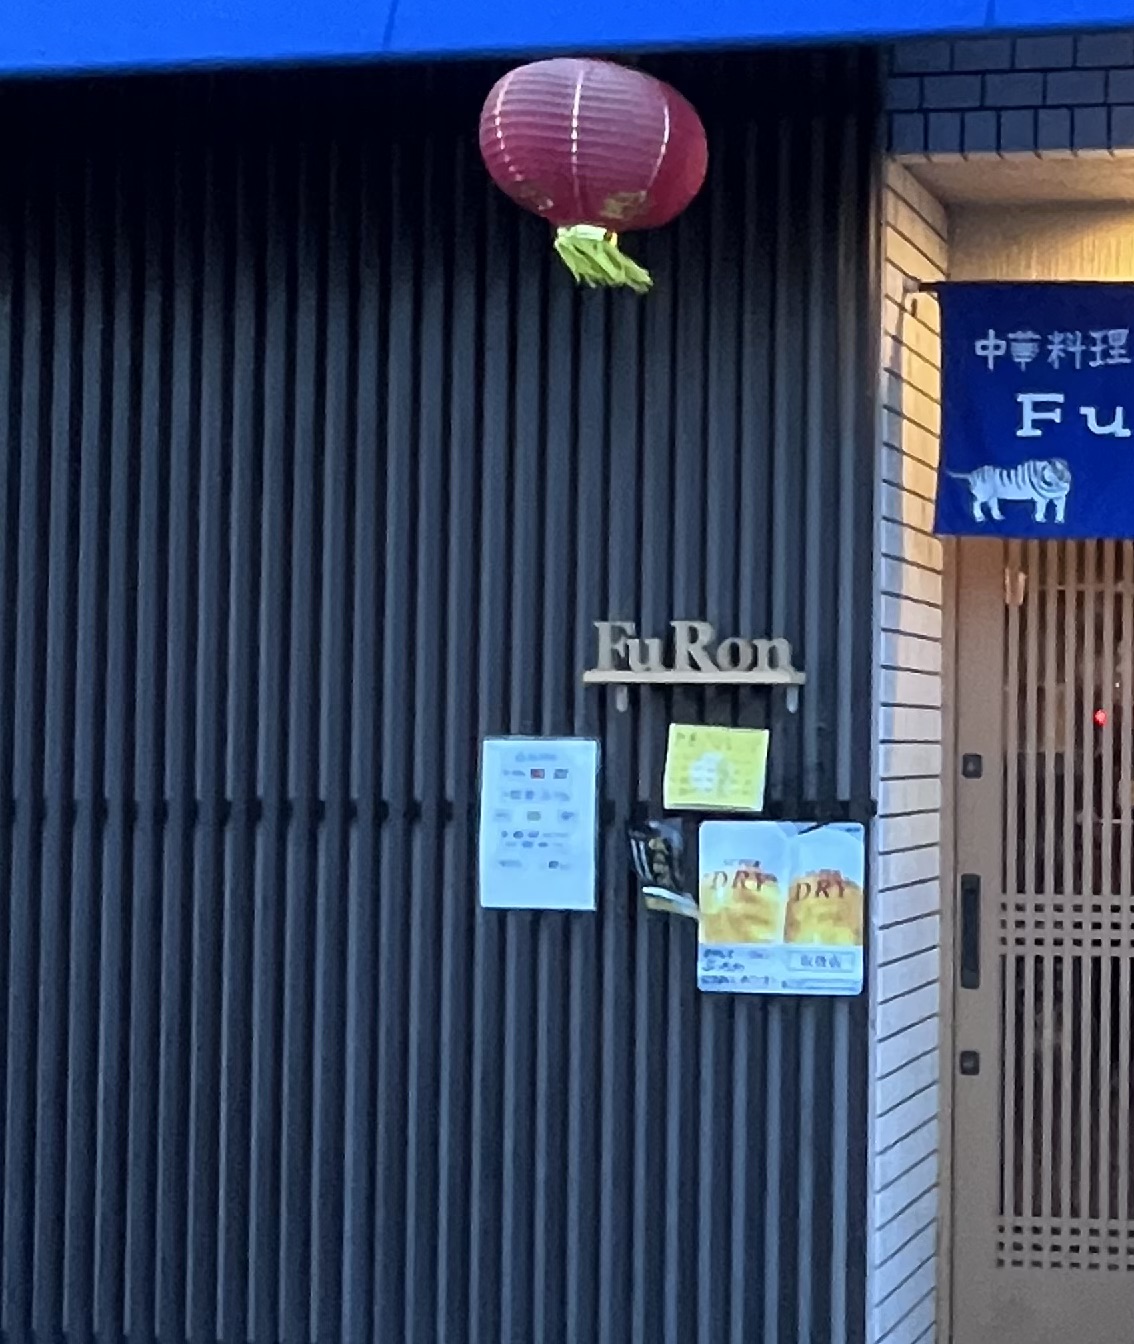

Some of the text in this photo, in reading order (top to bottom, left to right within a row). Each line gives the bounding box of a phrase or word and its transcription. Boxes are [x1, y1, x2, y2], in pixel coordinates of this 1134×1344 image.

[974, 328, 1132, 370] 中華料理
[1016, 393, 1132, 438] Fu
[593, 620, 795, 672] FuRon
